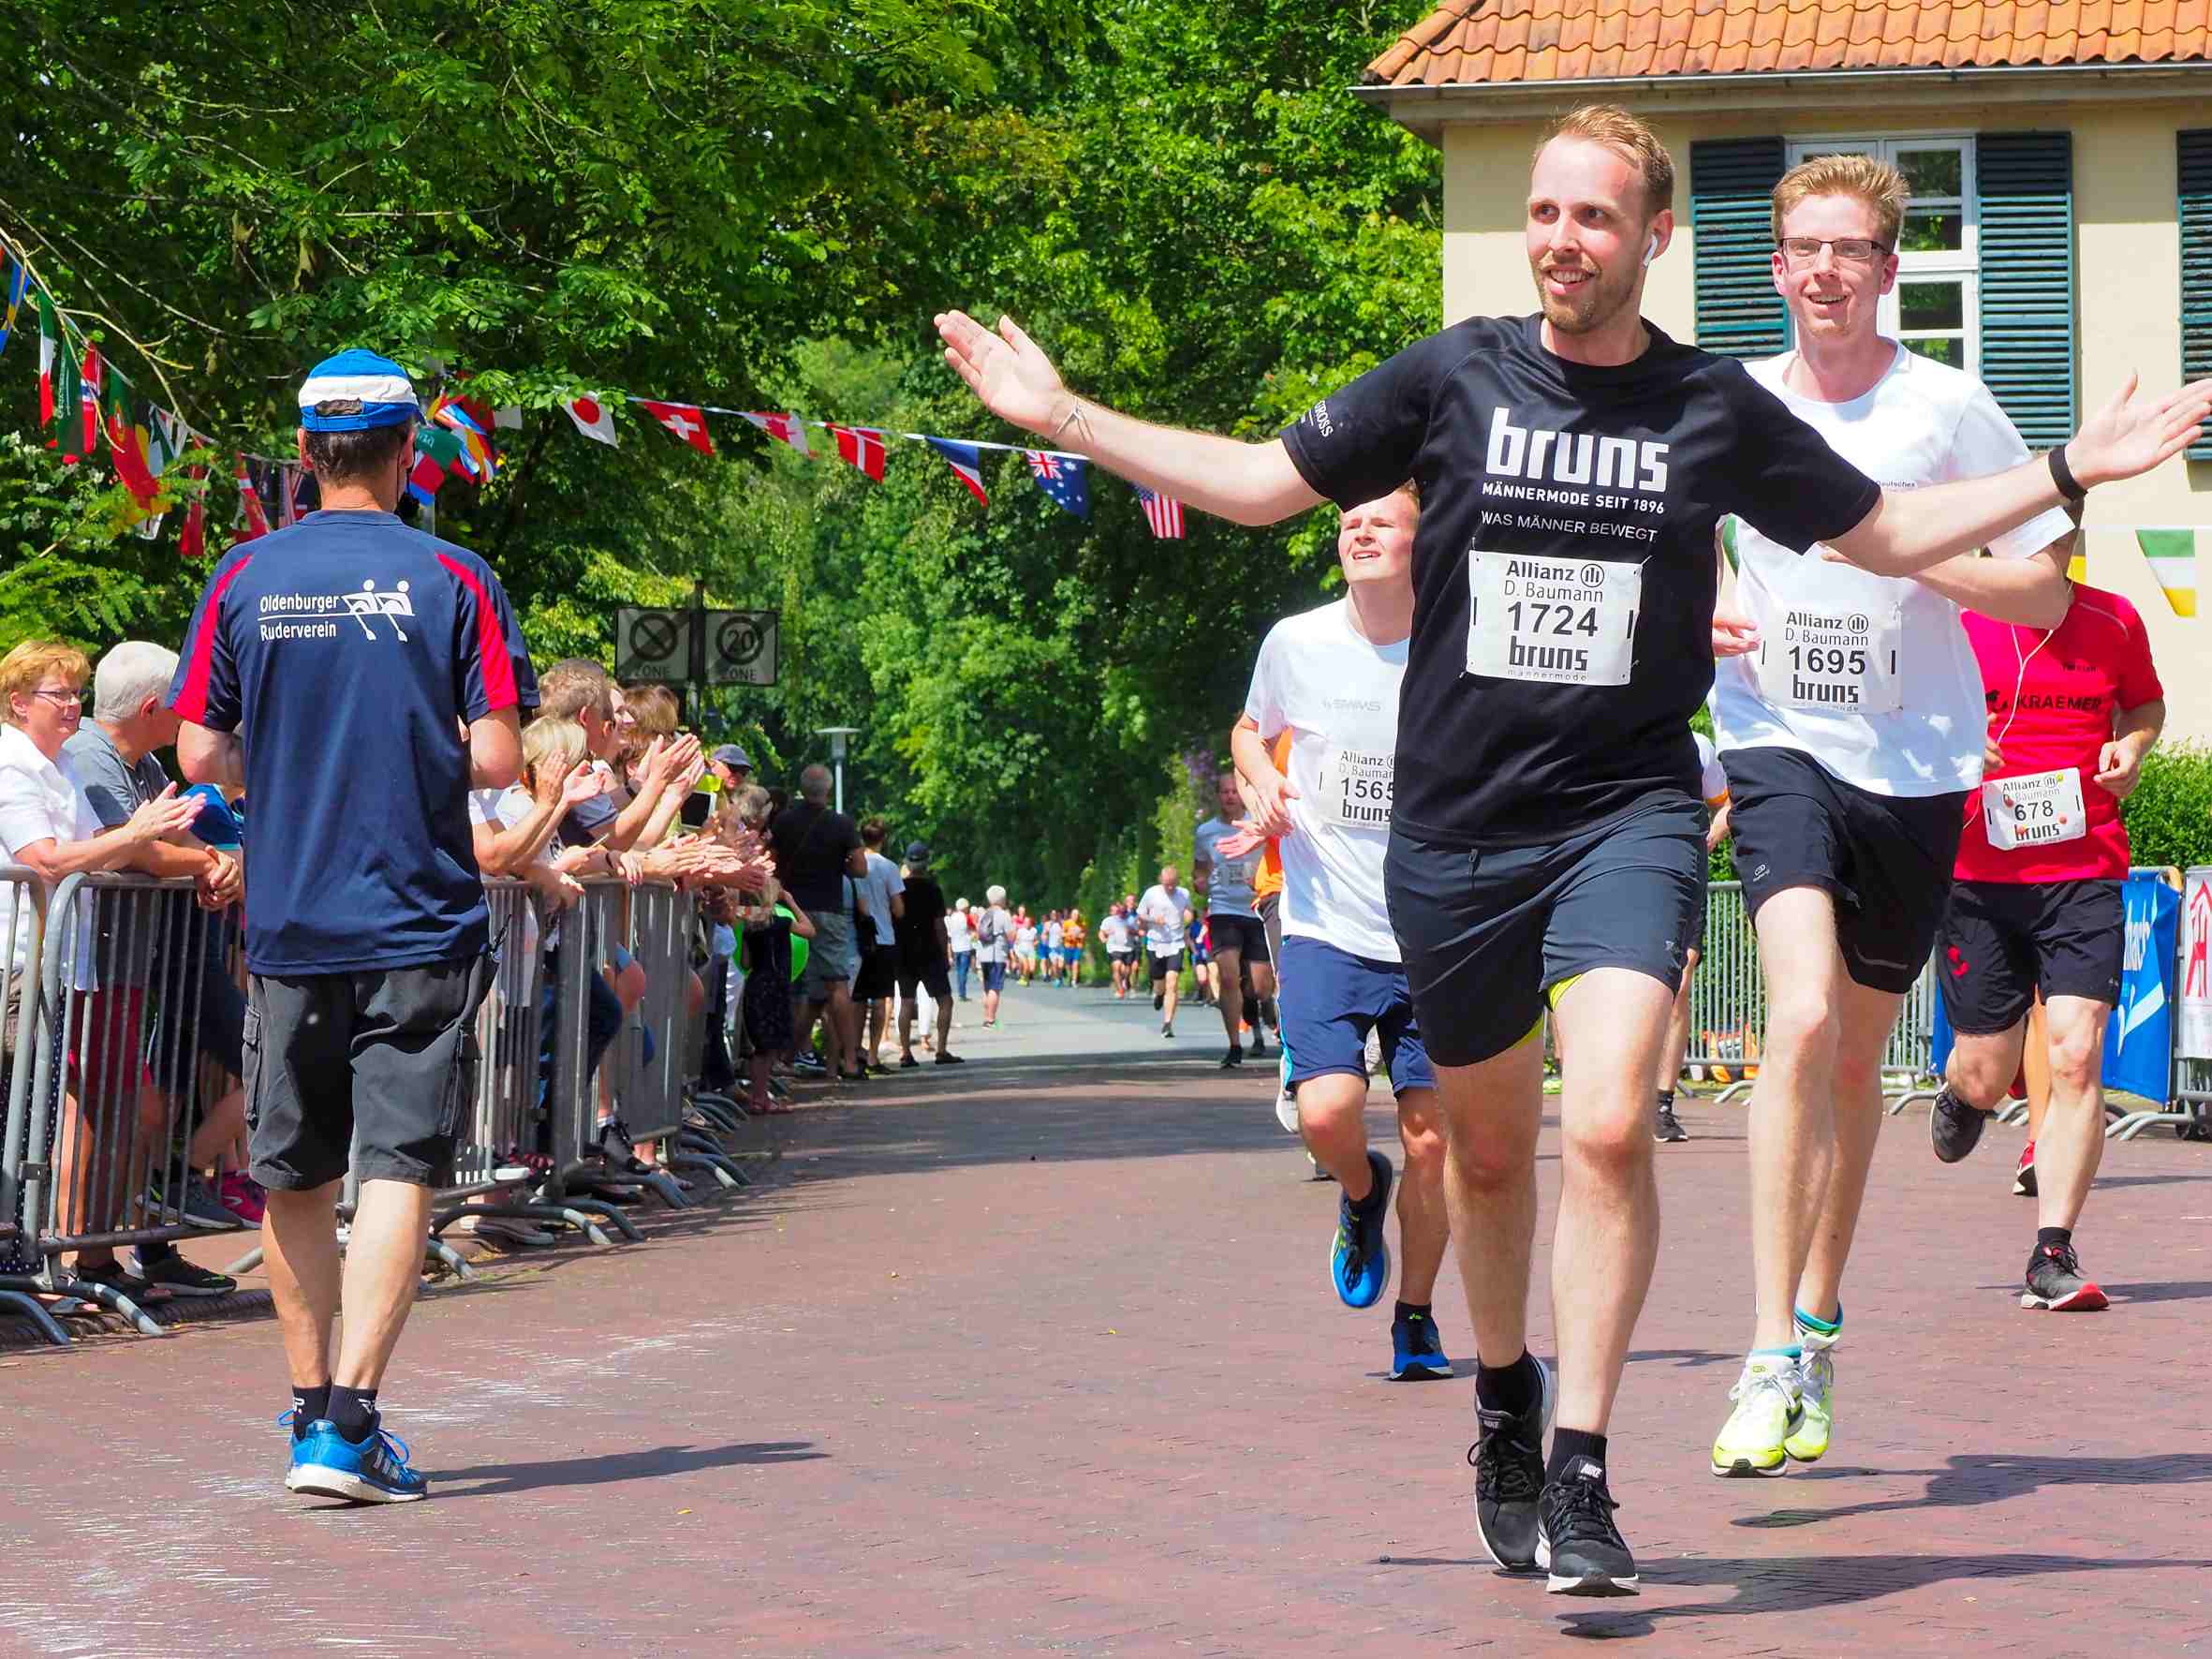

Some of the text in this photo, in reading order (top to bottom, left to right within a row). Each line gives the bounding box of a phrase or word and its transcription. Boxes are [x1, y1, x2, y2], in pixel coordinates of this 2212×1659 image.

[1485, 407, 1670, 493] bruns
[1482, 481, 1665, 514] MÄNNERMODE SEIT 1896
[1481, 511, 1513, 526] WAS
[1517, 514, 1586, 534] MÄNNER
[1505, 560, 1575, 582] Allianz
[1504, 580, 1603, 602] D. Baumann
[259, 593, 340, 613] Oldenburger
[1507, 600, 1600, 637] 1724
[1786, 612, 1844, 630] Allianz
[260, 621, 337, 641] Ruderverein
[727, 630, 755, 653] 20
[1785, 628, 1868, 645] D. Baumann
[1509, 635, 1588, 671] bruns
[1789, 645, 1865, 675] 1695
[1792, 674, 1859, 704] bruns
[2016, 694, 2102, 711] KRAEMER
[1340, 750, 1384, 766] Allianz
[1340, 778, 1394, 801] 1565
[2002, 779, 2041, 792] Allianz
[1342, 799, 1393, 822] bruns
[2014, 800, 2054, 821] 678
